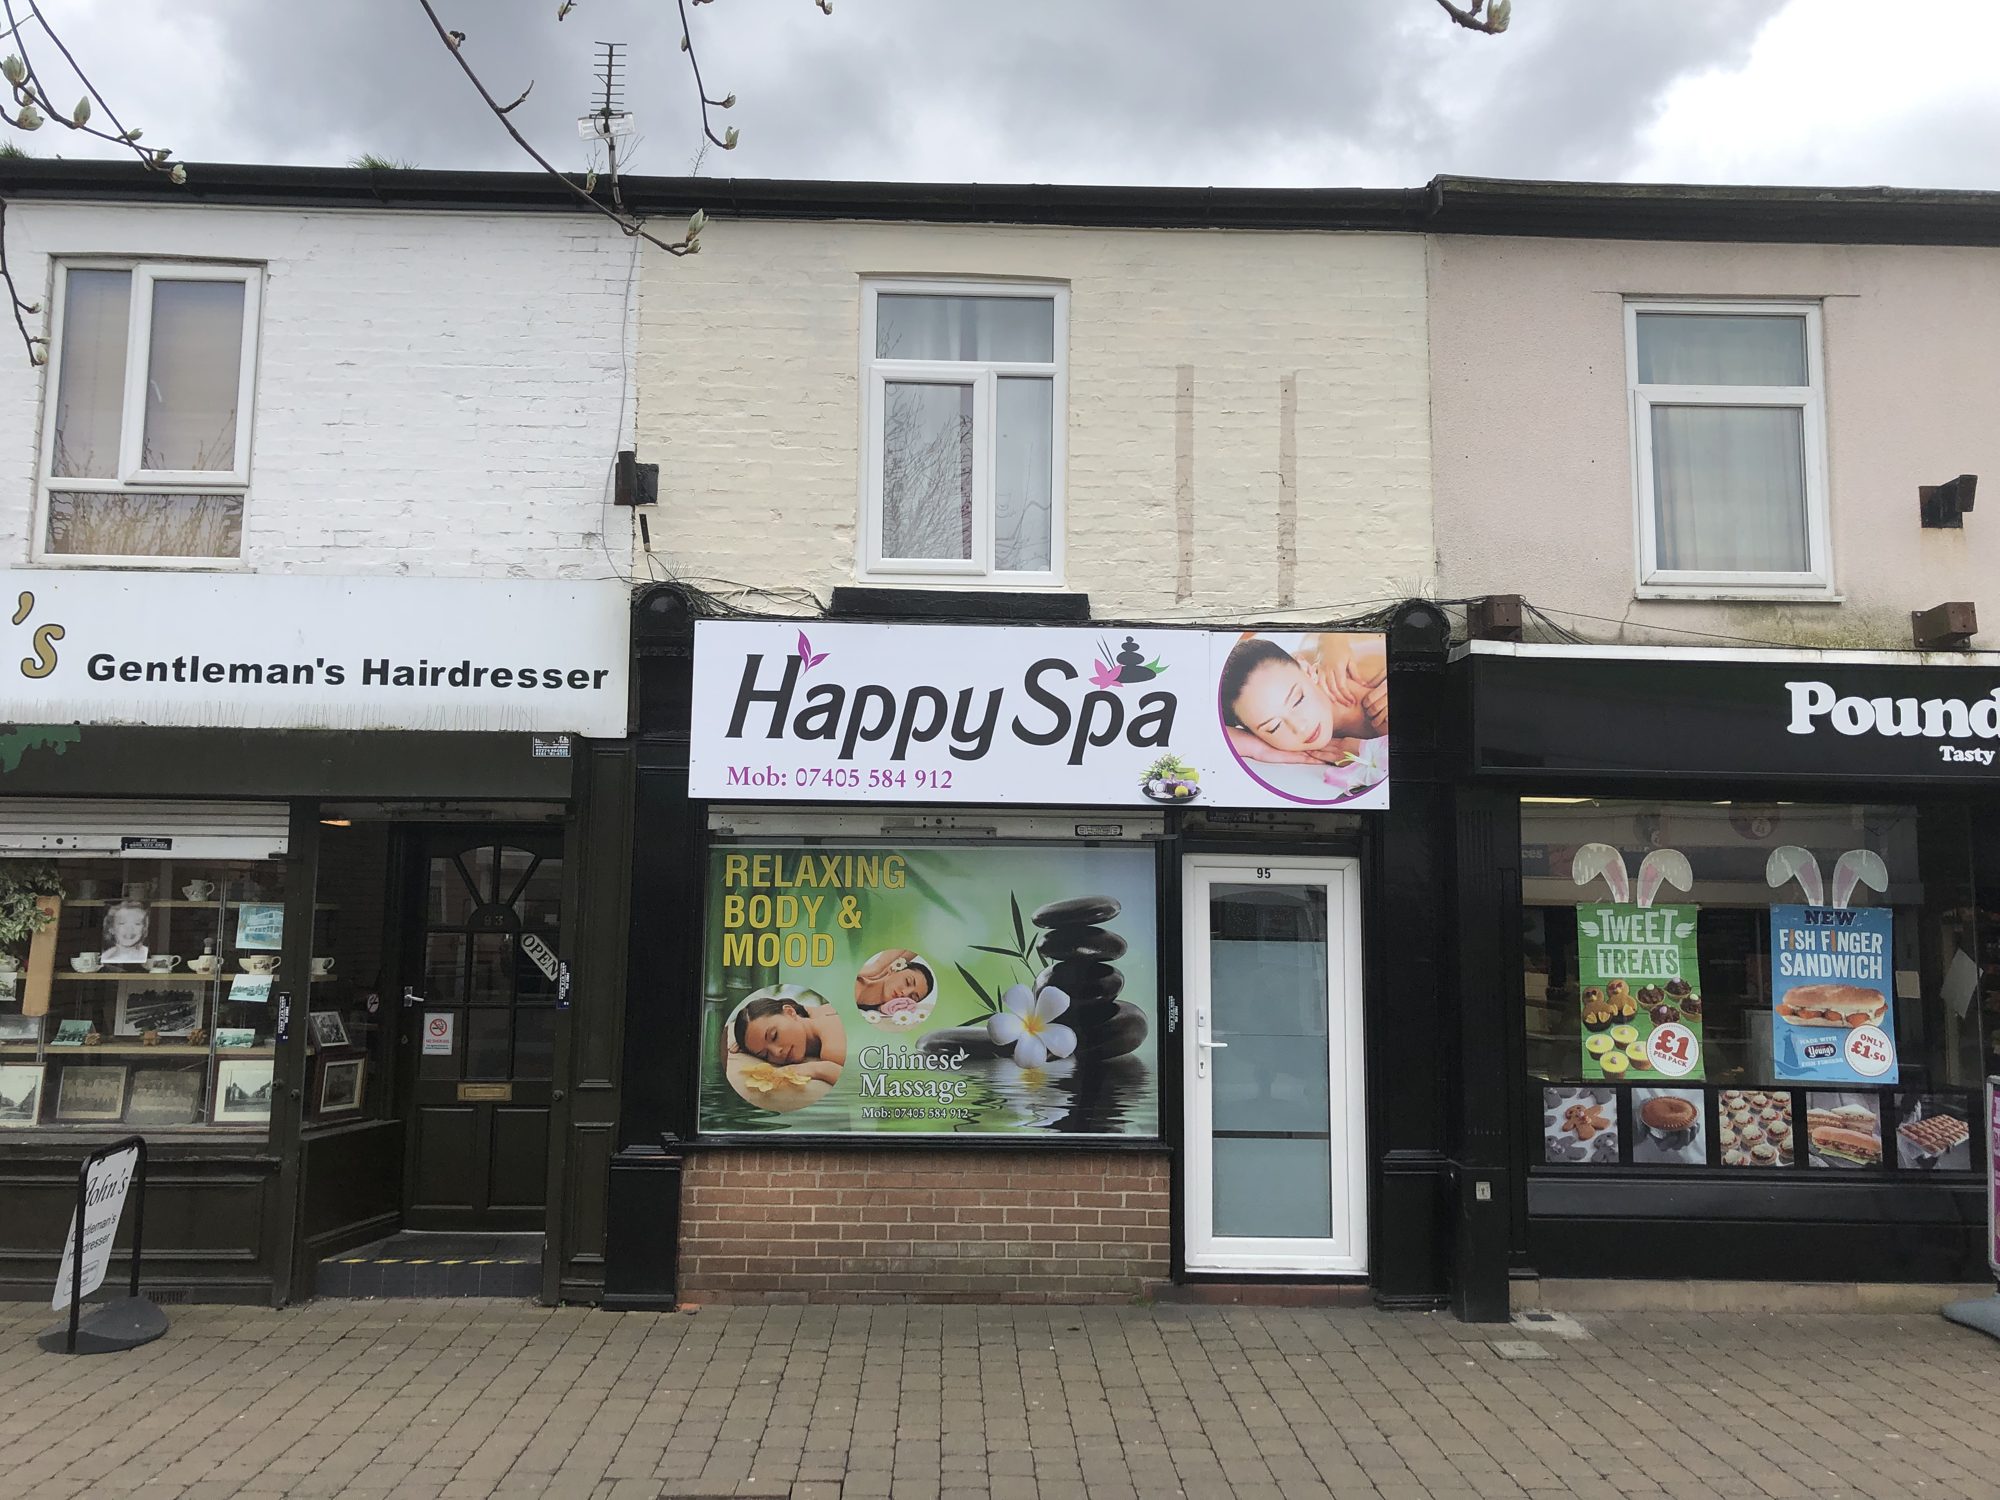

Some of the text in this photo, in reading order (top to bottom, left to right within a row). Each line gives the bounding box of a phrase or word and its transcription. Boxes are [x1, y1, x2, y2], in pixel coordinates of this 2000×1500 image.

[87, 653, 609, 690] Gentleman's Hairdresser
[725, 653, 1178, 765] Happy Spa
[1938, 745, 1996, 765] Tasty
[726, 765, 953, 789] Mob: 07405 584 912
[725, 854, 906, 889] RELAXING
[1256, 867, 1271, 879] 95
[724, 894, 863, 929] BODY &
[1803, 909, 1858, 927] NEW
[1596, 908, 1679, 944] TWEET
[722, 932, 835, 968] MOOD
[1779, 928, 1883, 954] FISH FINGER
[522, 935, 560, 977] OPEN
[1599, 948, 1680, 975] TREATS
[1780, 952, 1883, 980] SANDWICH
[1655, 1029, 1690, 1060] £1
[1860, 1033, 1885, 1049] ONLY
[859, 1044, 963, 1071] Chinese
[1653, 1050, 1687, 1067] PER PACK
[859, 1073, 967, 1105] Massage
[862, 1106, 969, 1119] Mob: 07405 584 912
[85, 1168, 128, 1206] John's
